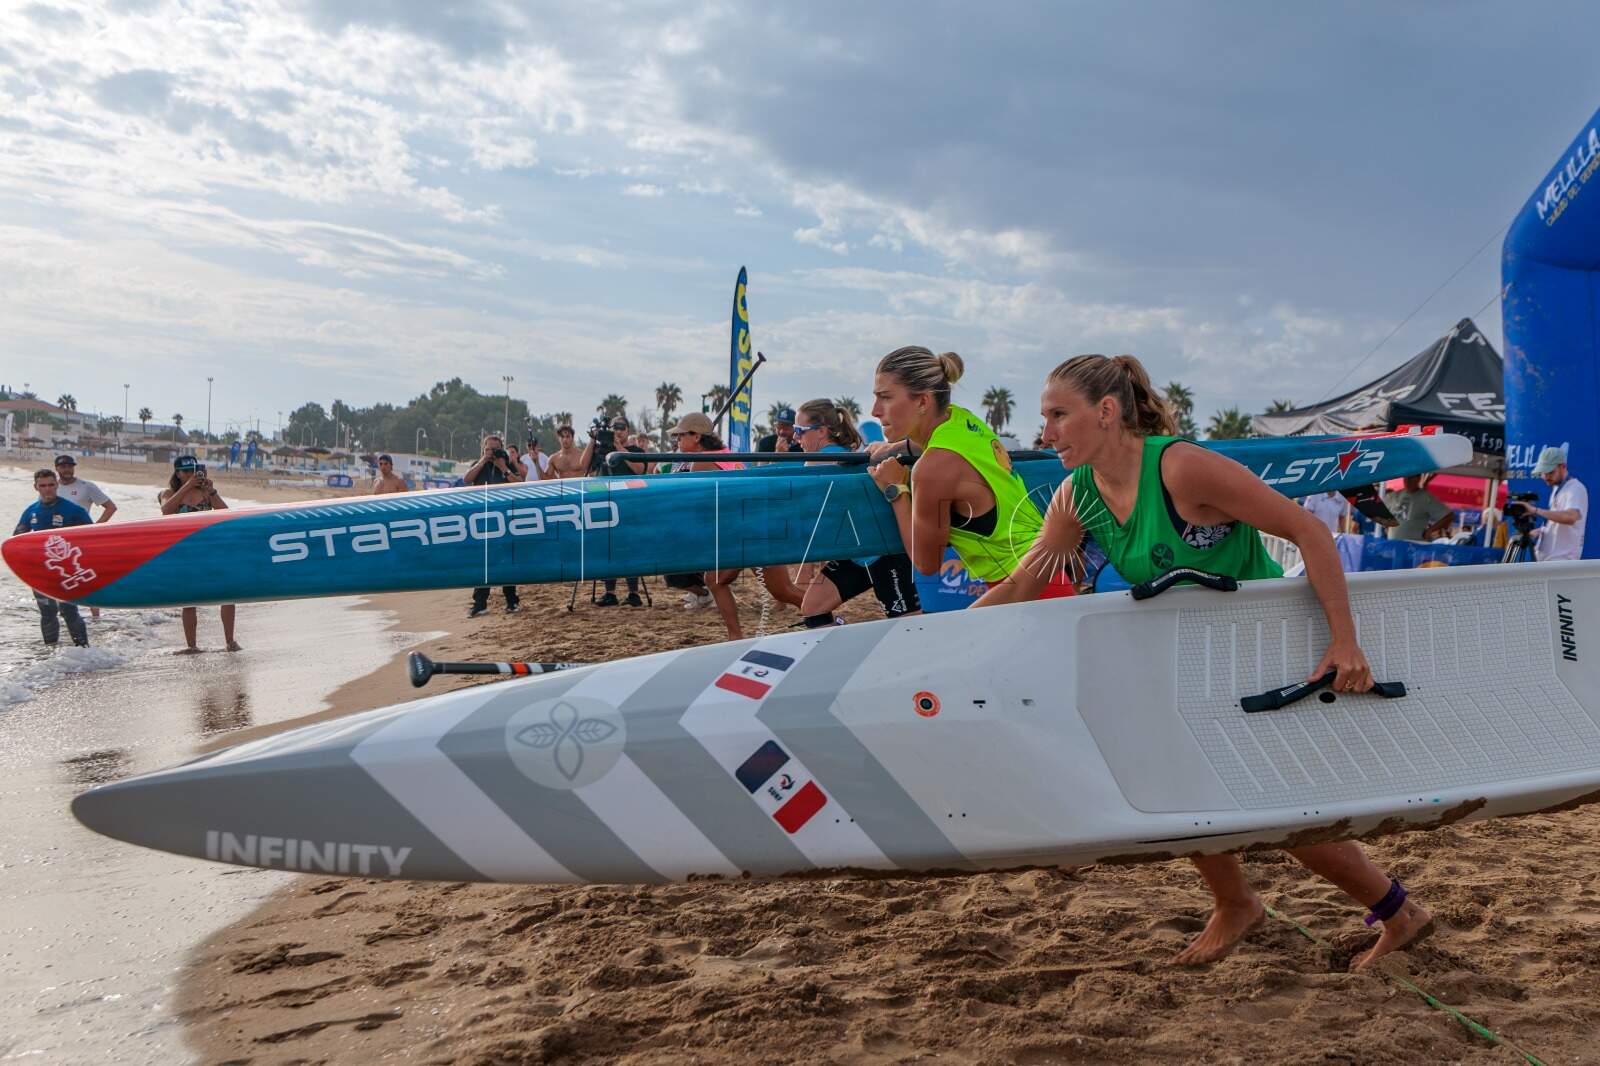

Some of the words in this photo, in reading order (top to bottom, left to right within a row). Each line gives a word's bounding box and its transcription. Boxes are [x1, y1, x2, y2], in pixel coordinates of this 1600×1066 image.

[1536, 127, 1600, 220] MELILLA
[1557, 593, 1578, 662] INFINITY
[206, 830, 413, 876] INFINITY
